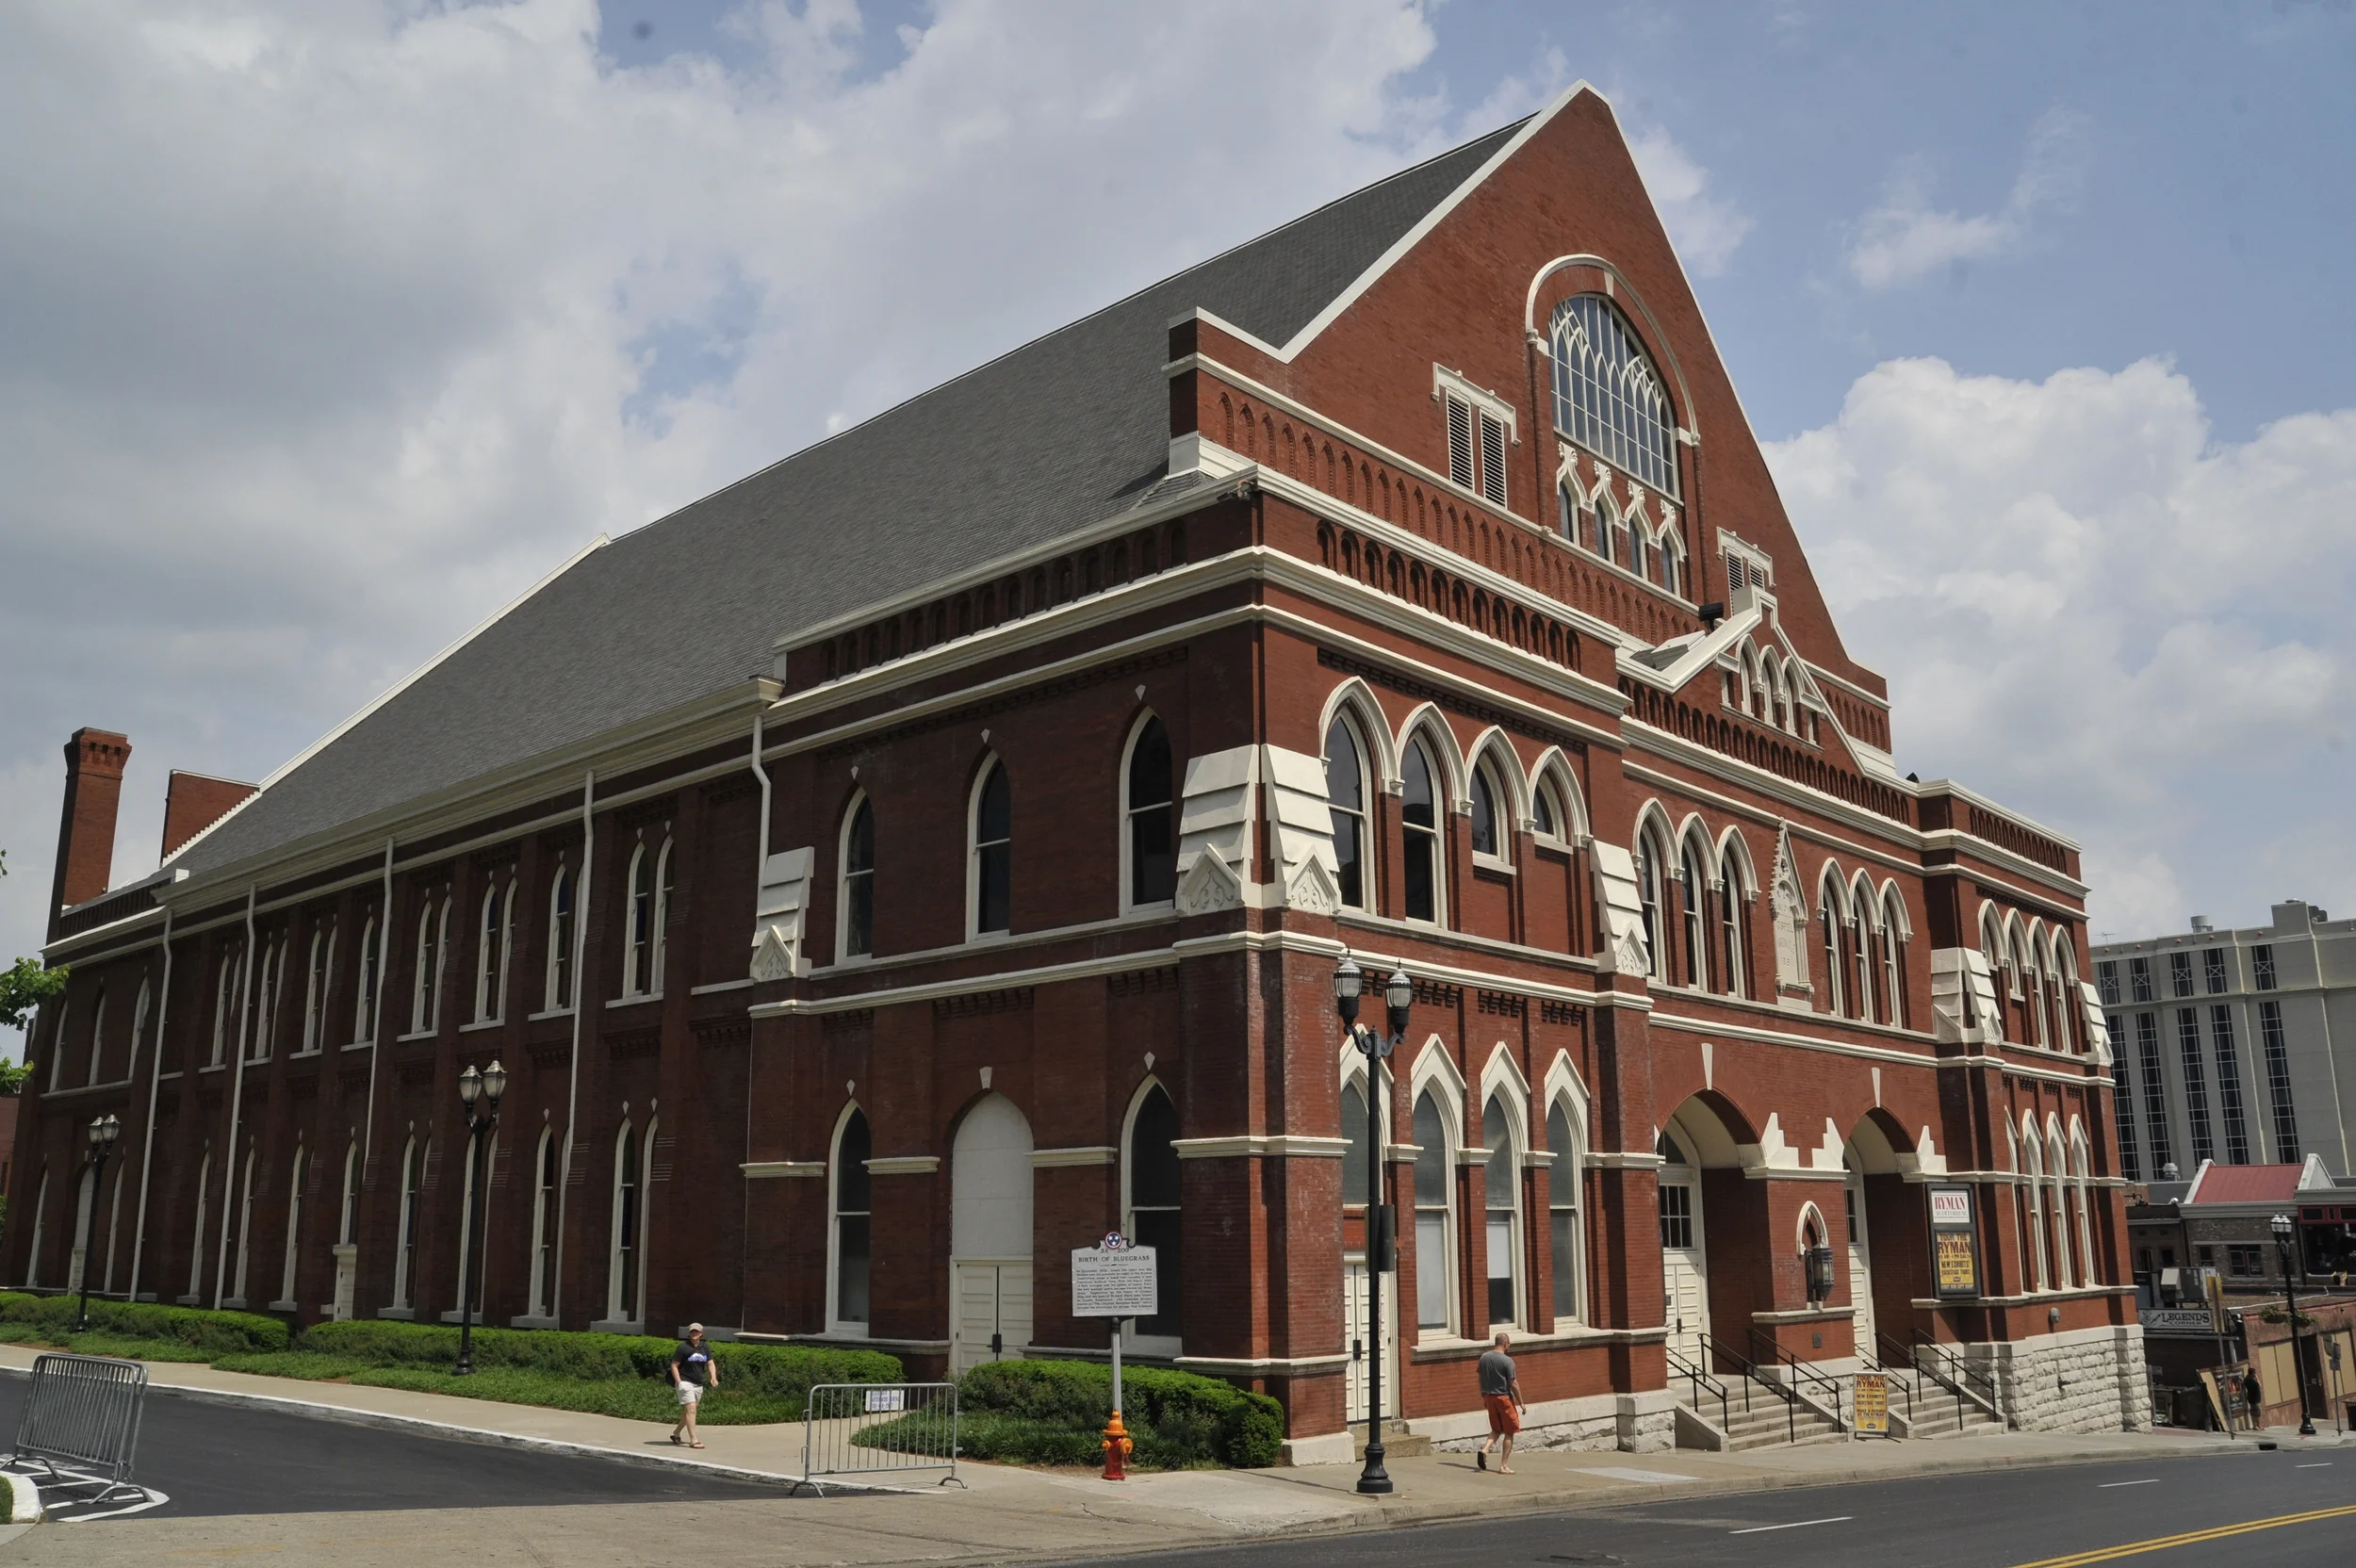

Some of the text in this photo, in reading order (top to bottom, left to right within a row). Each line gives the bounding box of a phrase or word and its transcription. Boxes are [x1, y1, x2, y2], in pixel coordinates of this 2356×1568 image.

[1935, 1197, 1966, 1210] RYMAN
[1938, 1241, 1972, 1253] RYMAN
[2162, 1313, 2210, 1323] LEGENDS
